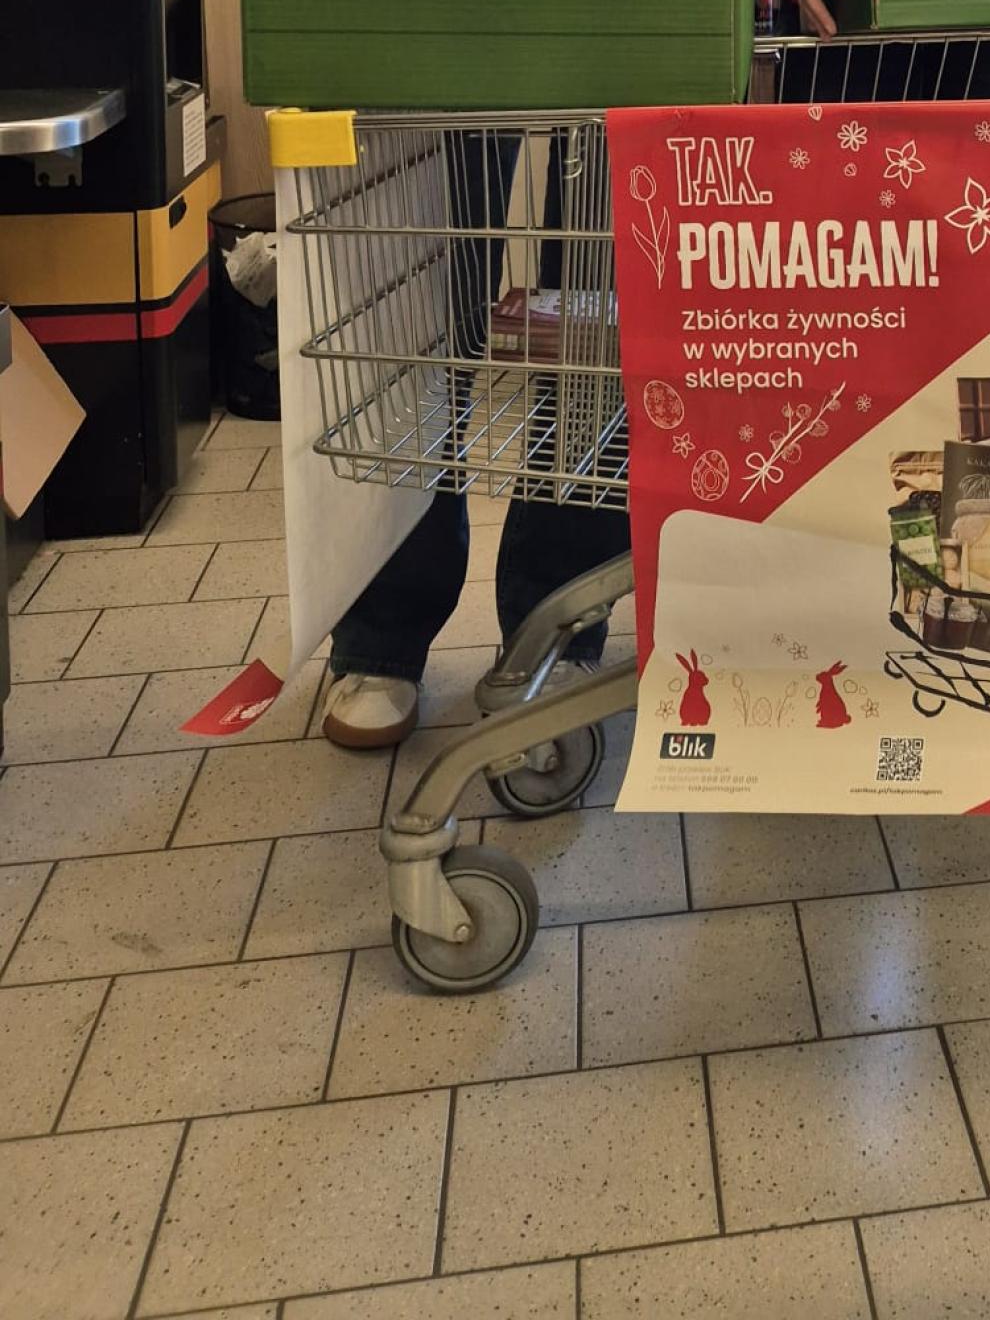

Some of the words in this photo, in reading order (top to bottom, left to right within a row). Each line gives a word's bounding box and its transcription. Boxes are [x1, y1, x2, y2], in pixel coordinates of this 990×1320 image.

[667, 137, 773, 206] TAK.
[677, 219, 940, 290] POMAGAM!
[681, 308, 779, 331] Zbiórka
[786, 306, 907, 336] żywności
[683, 342, 705, 360] w
[711, 337, 859, 366] wybranych
[685, 367, 803, 394] sklepach
[668, 735, 707, 757] blik
